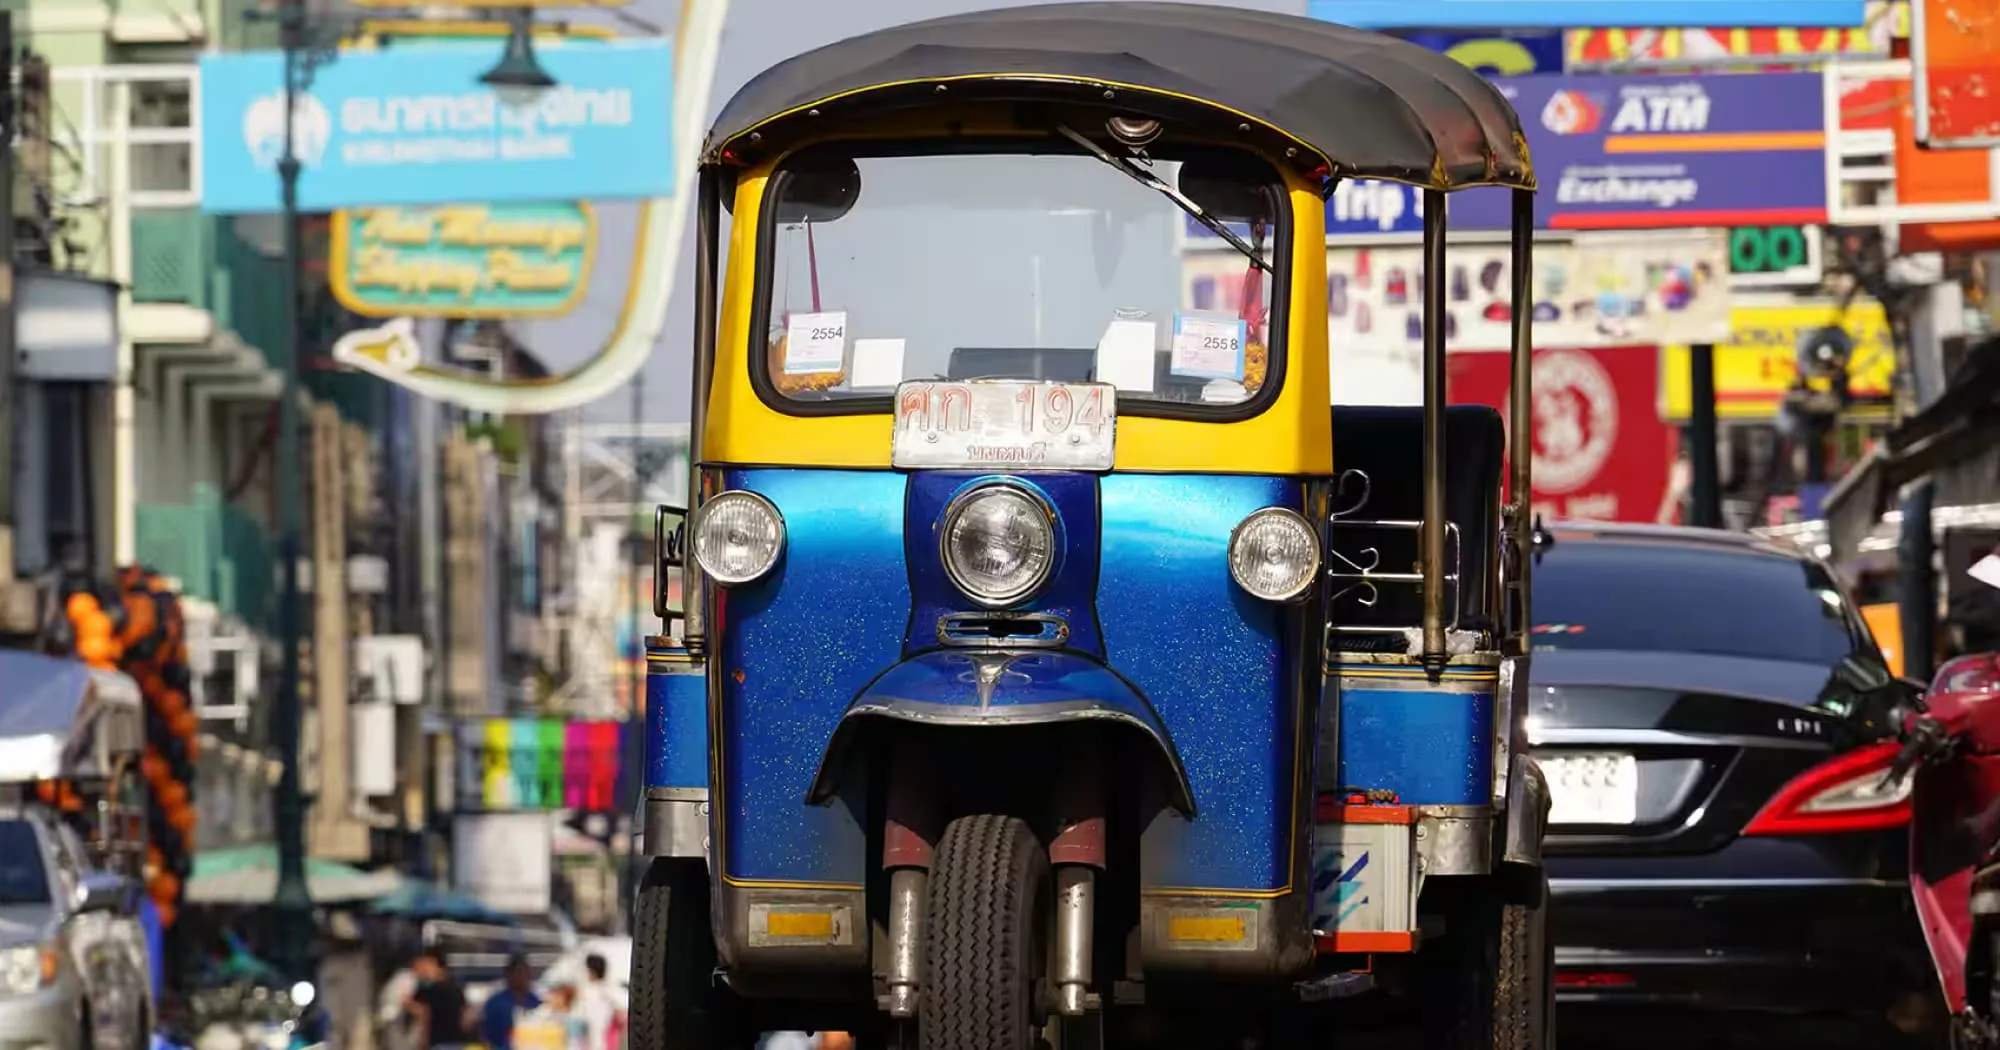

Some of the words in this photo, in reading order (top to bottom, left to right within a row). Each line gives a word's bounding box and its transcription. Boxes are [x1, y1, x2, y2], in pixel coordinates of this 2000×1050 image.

[1611, 98, 1711, 132] ATM
[1557, 178, 1698, 206] Exchange
[811, 326, 843, 340] 2554
[1015, 385, 1106, 435] 194
